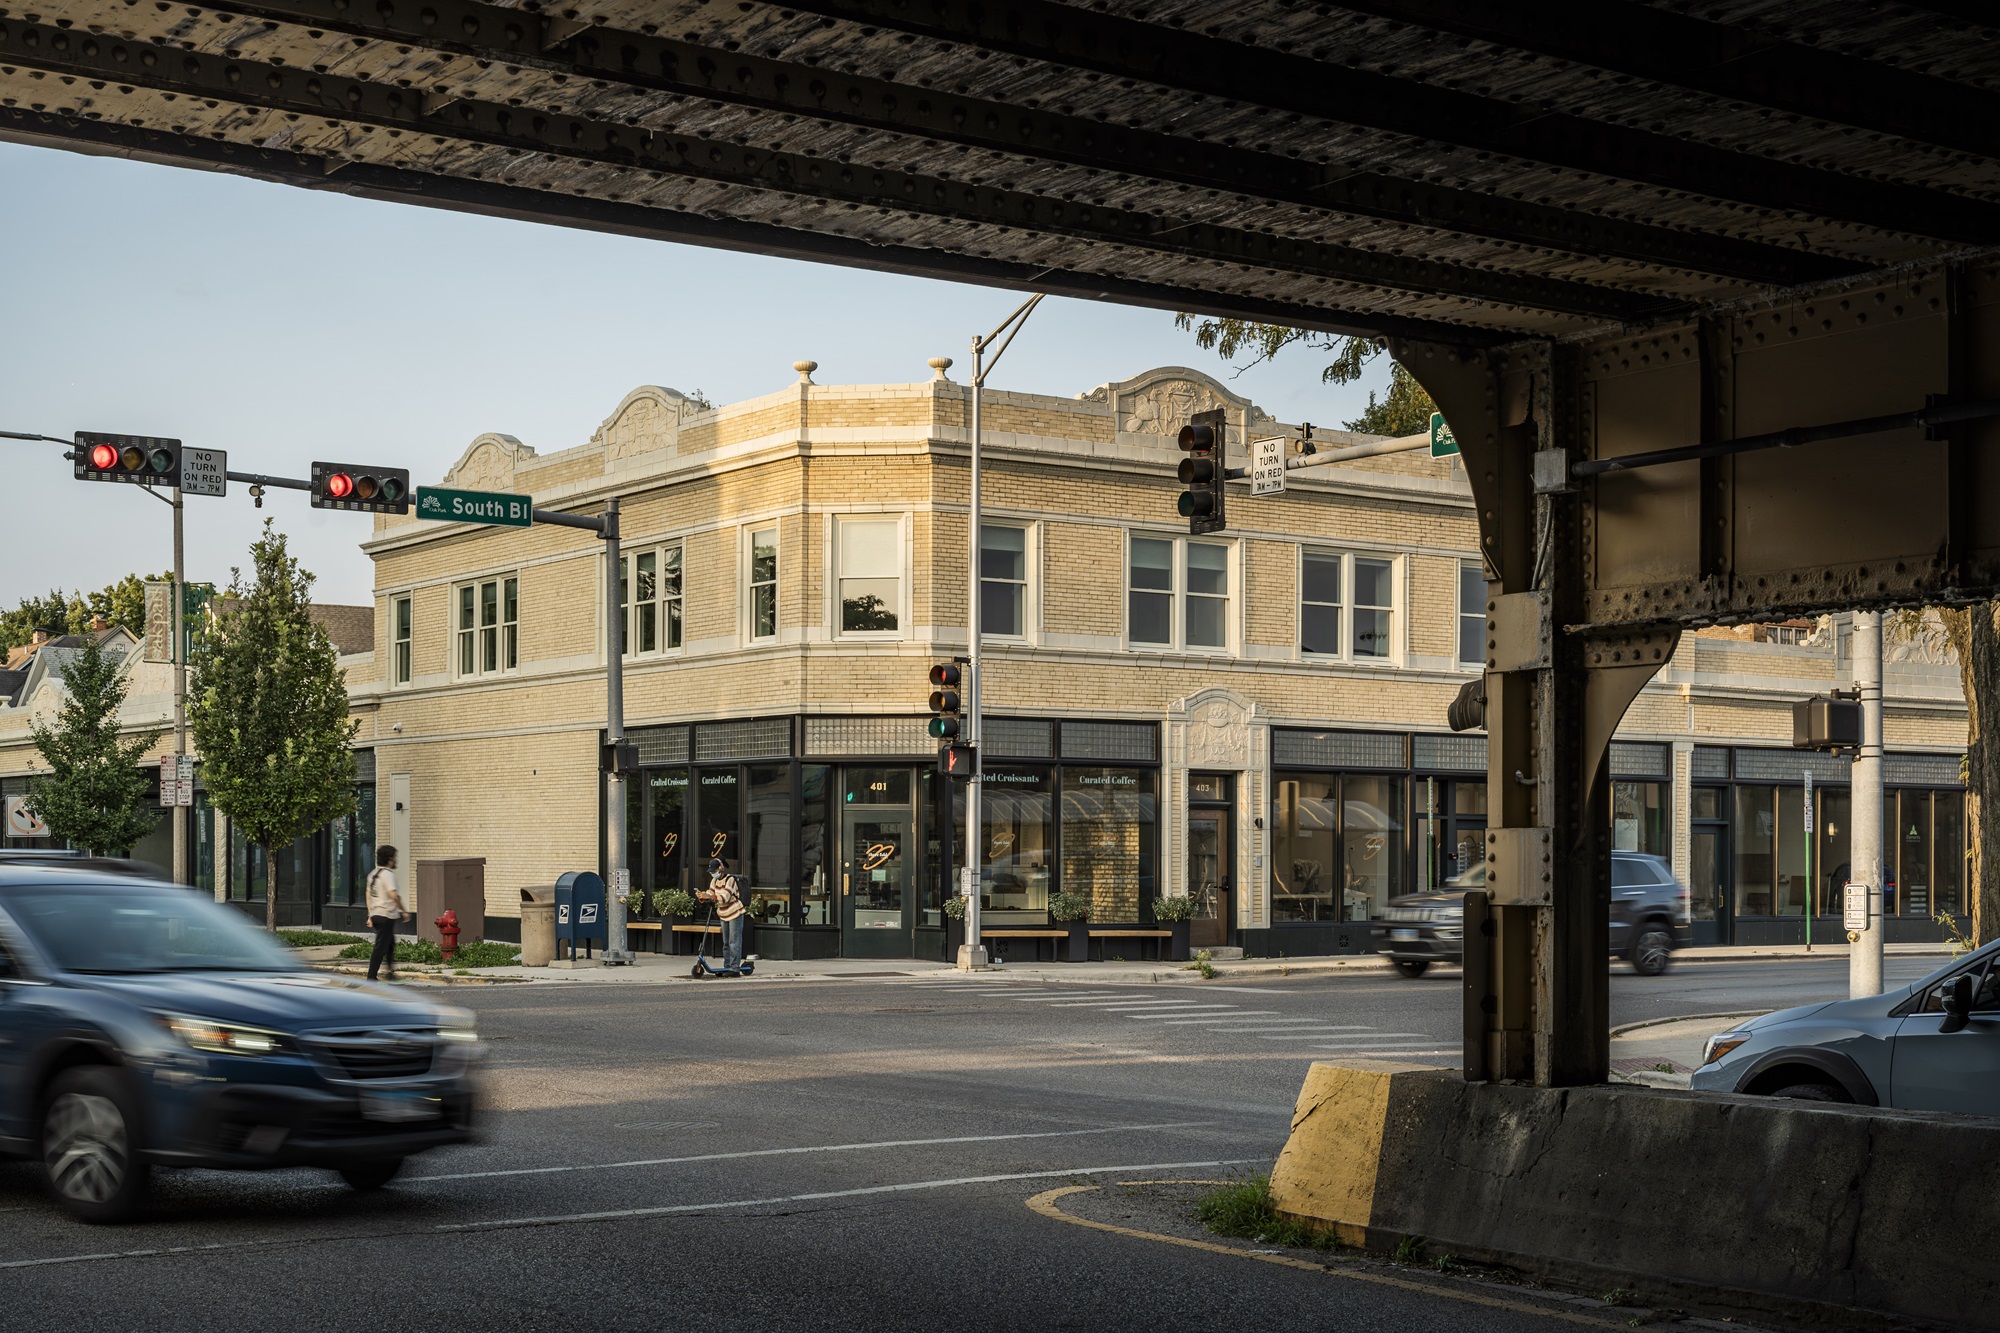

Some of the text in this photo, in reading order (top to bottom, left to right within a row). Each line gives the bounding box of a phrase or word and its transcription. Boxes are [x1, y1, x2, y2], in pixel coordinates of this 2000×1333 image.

[1263, 443, 1275, 453] NO
[195, 452, 212, 461] NO
[1259, 455, 1279, 466] TURN
[190, 462, 217, 472] TURN
[184, 472, 222, 484] ON RED
[1254, 467, 1282, 480] ON RED
[452, 497, 528, 520] South Bl
[701, 775, 736, 784] Curated Coffee
[997, 773, 1040, 783] Croissants
[1079, 775, 1136, 785] Curated Coffee
[870, 782, 887, 791] 401
[1195, 784, 1210, 792] 403
